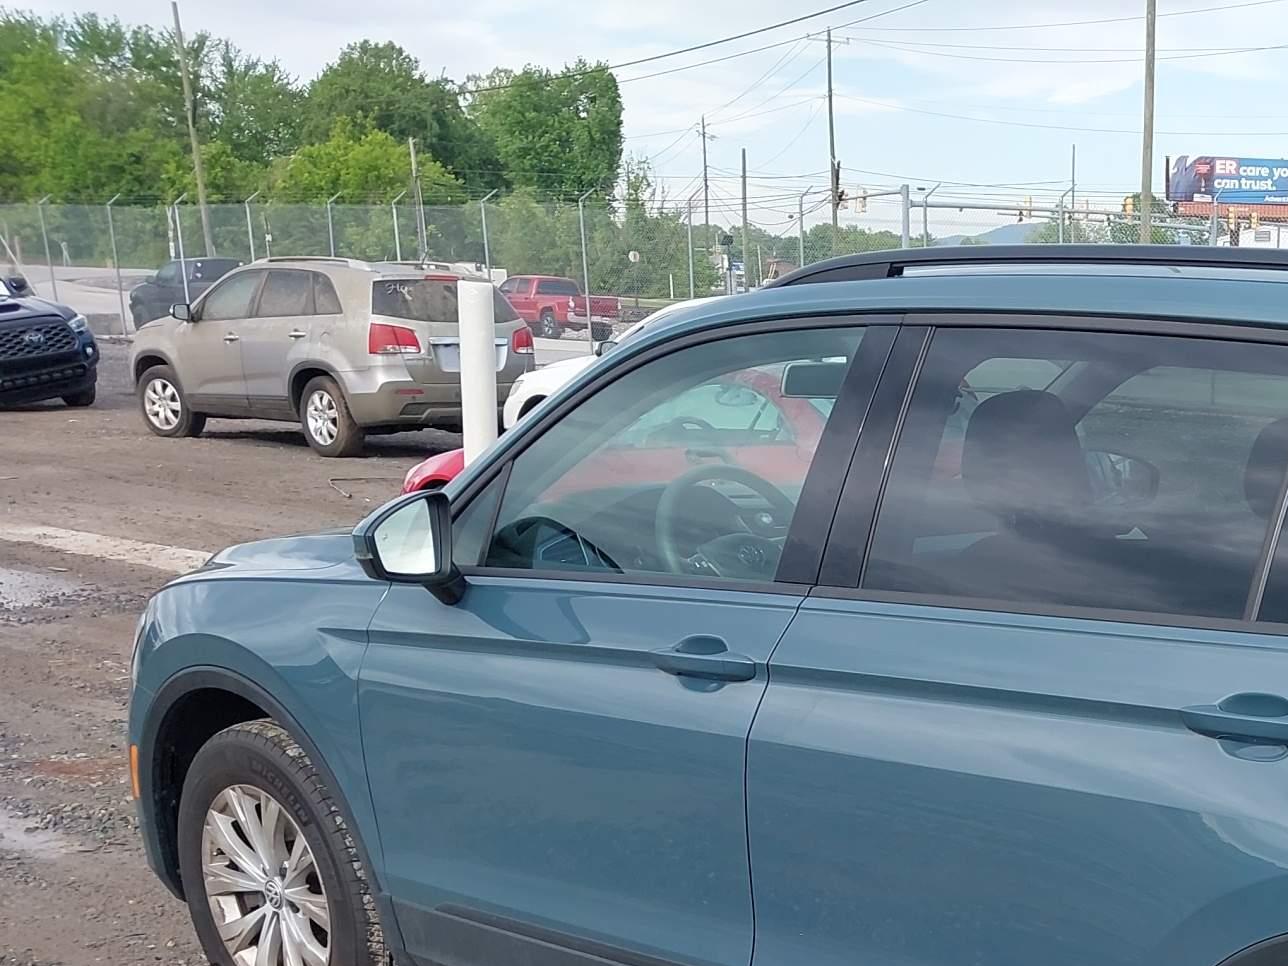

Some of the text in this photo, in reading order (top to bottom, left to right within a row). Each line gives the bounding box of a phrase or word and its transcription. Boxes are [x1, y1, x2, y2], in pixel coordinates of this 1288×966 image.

[1215, 159, 1237, 175] ER
[1239, 166, 1270, 177] care
[1213, 177, 1277, 191] can trust.
